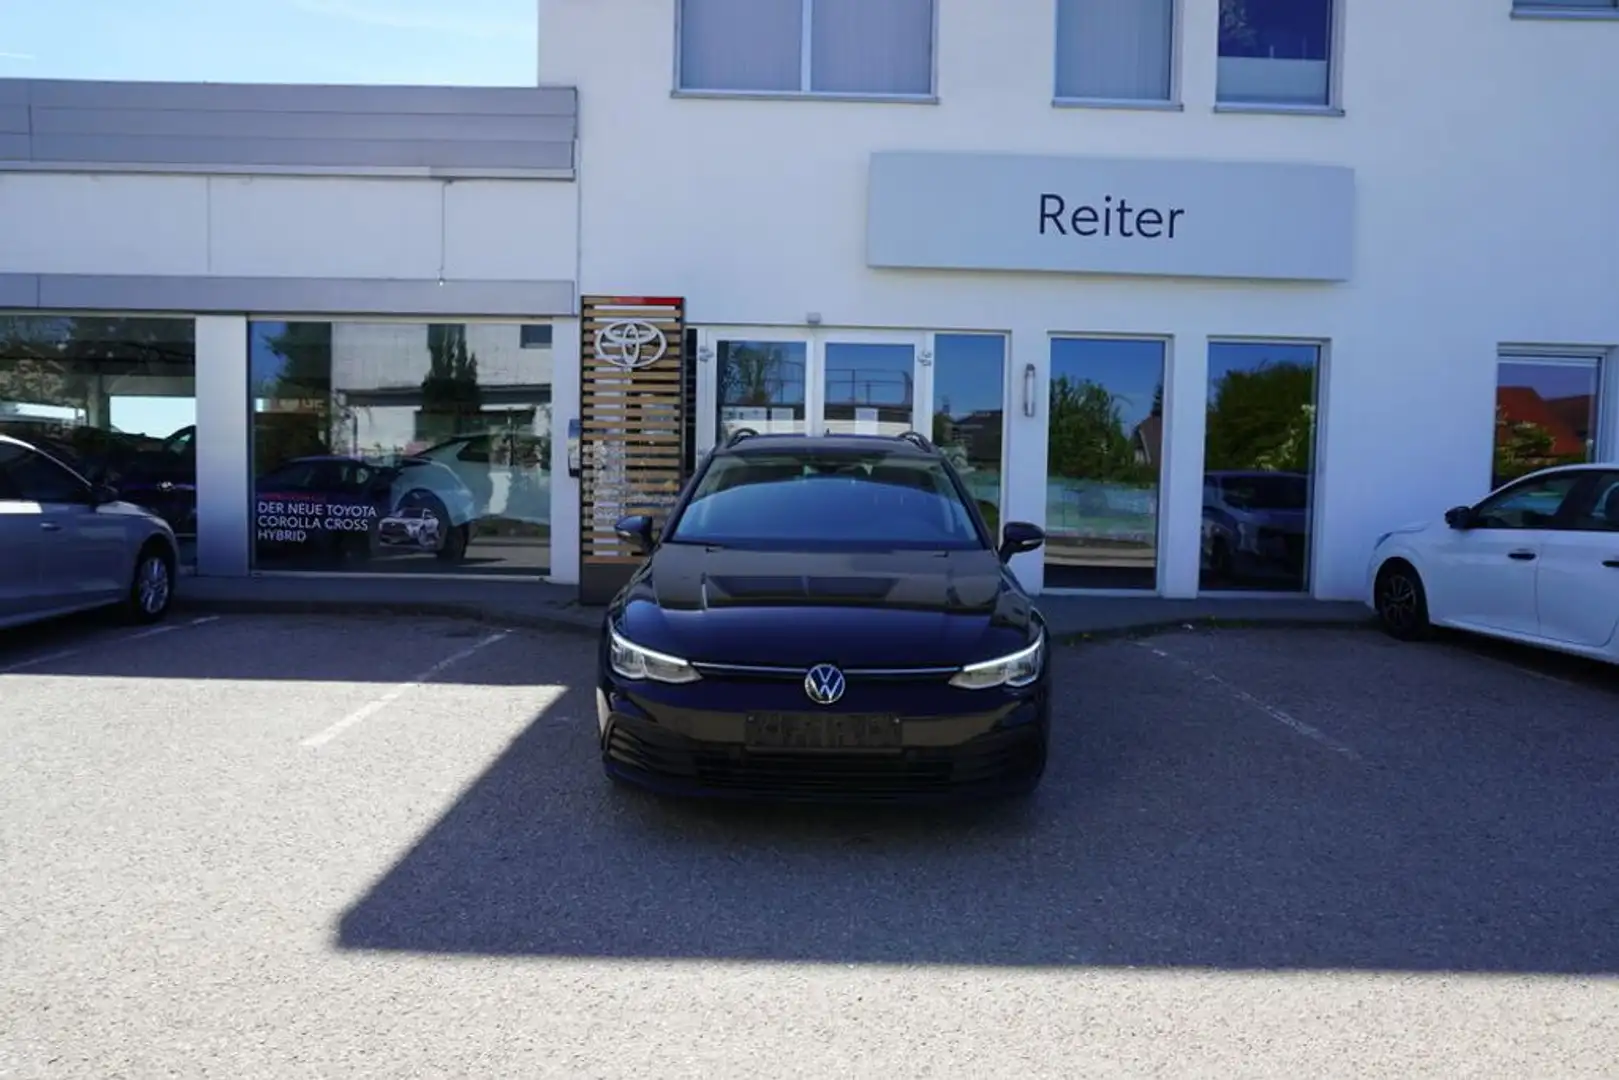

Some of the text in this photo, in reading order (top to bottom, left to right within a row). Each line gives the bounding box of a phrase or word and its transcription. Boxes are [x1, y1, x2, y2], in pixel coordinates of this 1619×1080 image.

[1039, 193, 1185, 239] Reiter
[258, 502, 377, 517] DER NEUE TOYOTA
[257, 515, 369, 531] COROLLA CROSS
[257, 529, 307, 542] HYBRID
[806, 665, 845, 704] VW
